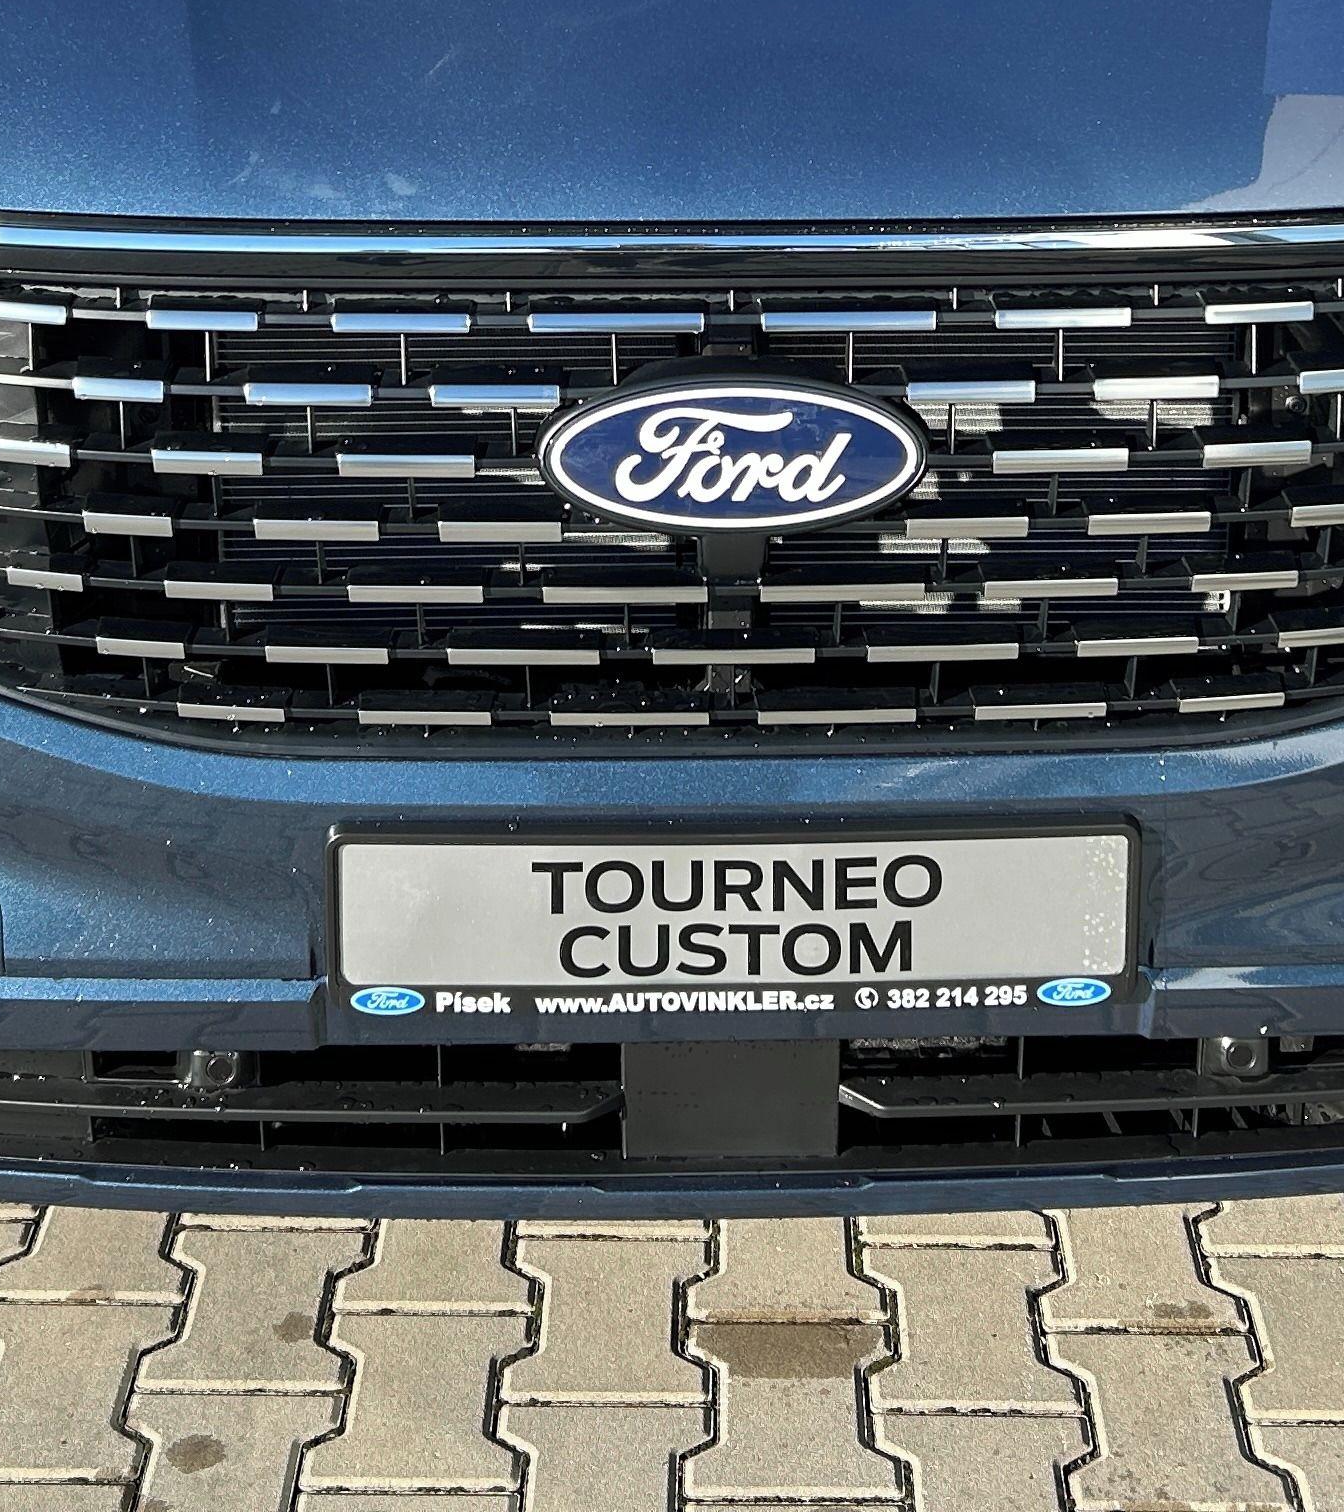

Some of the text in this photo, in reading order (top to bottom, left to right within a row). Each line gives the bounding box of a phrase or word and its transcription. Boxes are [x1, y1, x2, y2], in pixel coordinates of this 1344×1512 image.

[614, 406, 853, 504] Ford
[531, 854, 943, 915] TOURNEO
[558, 919, 913, 979] CUSTOM
[435, 991, 512, 1014] Písek
[534, 990, 835, 1014] www.AUTOVINKLER.cz
[886, 987, 930, 1009] 382
[935, 987, 979, 1009] 214
[983, 985, 1028, 1006] 295
